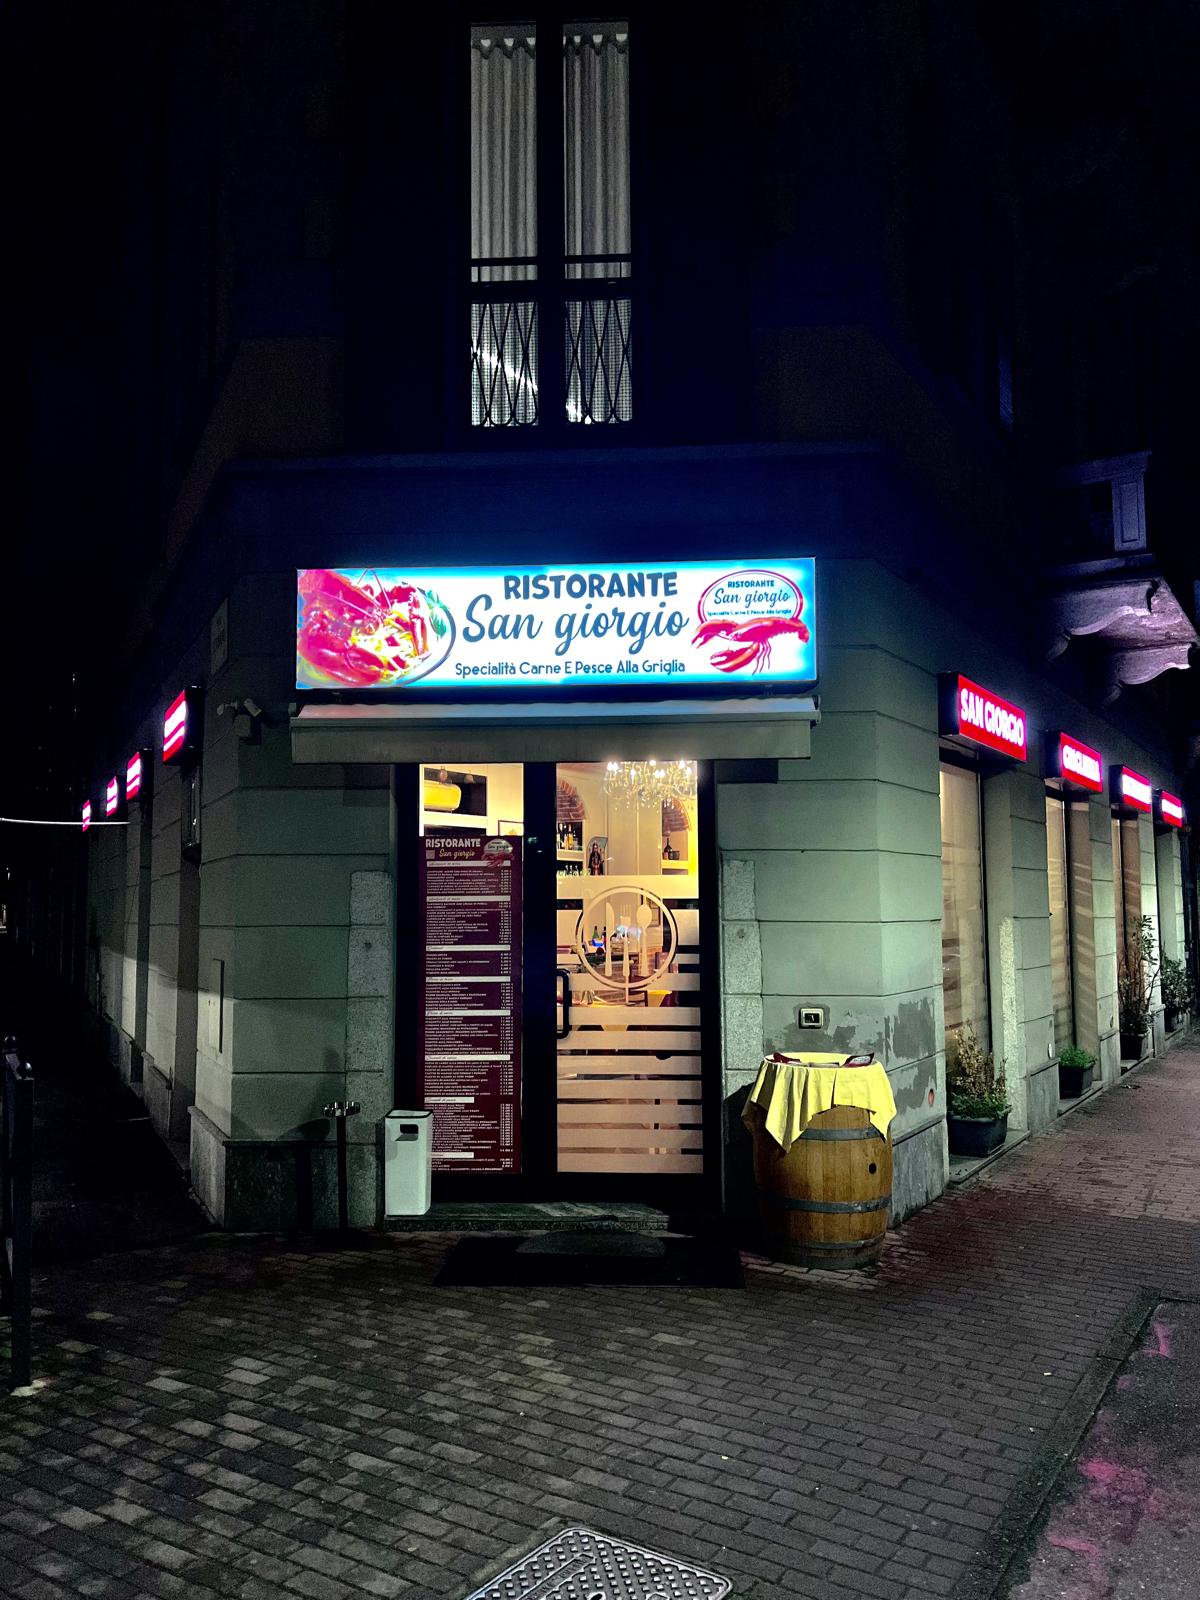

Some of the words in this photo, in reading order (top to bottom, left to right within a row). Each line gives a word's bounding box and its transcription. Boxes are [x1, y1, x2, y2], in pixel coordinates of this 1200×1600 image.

[503, 572, 679, 600] RISTORANTE
[728, 579, 775, 588] RISTORANTE
[714, 588, 741, 604] San
[744, 590, 791, 609] giorgio
[462, 594, 544, 643] San
[554, 601, 690, 657] giorgio
[455, 661, 517, 679] Specialità
[519, 661, 562, 675] Carne
[564, 661, 572, 674] E
[575, 661, 614, 674] Pesce
[616, 660, 639, 673] Alla
[641, 659, 686, 676] Griglia
[960, 688, 984, 729] SAN
[984, 701, 1025, 747] GIORGIO
[425, 838, 481, 847] RISTORANTE
[439, 848, 452, 857] San
